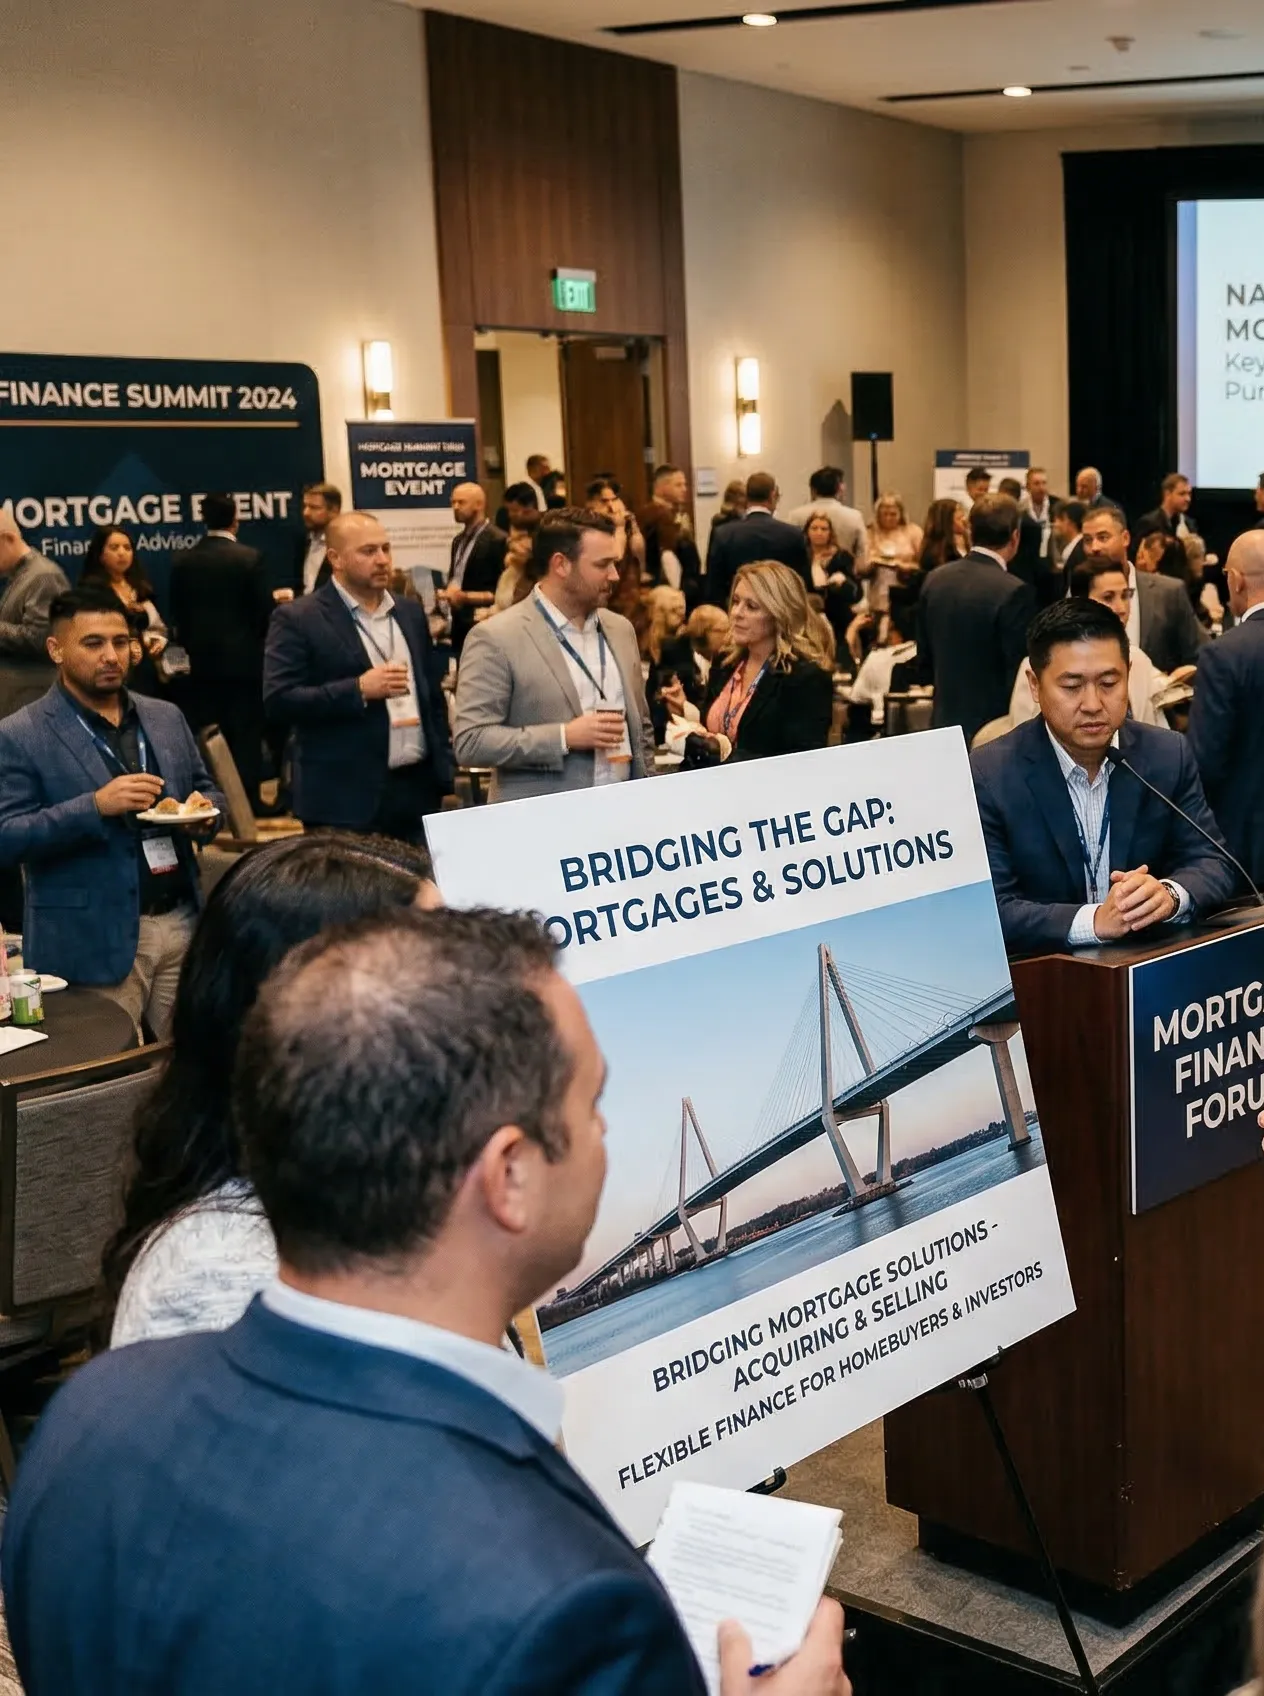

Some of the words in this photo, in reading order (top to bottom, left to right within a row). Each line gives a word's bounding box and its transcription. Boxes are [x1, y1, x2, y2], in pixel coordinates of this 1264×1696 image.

[126, 383, 233, 409] SUMMIT
[237, 386, 298, 410] 2024
[191, 491, 293, 522] EENT
[360, 461, 466, 478] MORTGAGE
[384, 480, 446, 496] EVENT
[543, 876, 743, 951] ORTGAGES
[752, 870, 776, 903] &
[781, 829, 954, 896] SOLUTIONS
[560, 826, 743, 893] BRIDGING
[748, 811, 816, 852] THE
[823, 797, 895, 837] GAP:
[652, 1324, 764, 1393] BRIDGING
[768, 1267, 883, 1339] MORTGAGE
[886, 1220, 989, 1283] SOLUTIONS
[733, 1317, 850, 1393] ACQUIRING
[854, 1308, 868, 1331] &
[871, 1270, 948, 1323] SELLING
[618, 1426, 712, 1490] FLEXIBLE
[715, 1384, 797, 1441] FINANCE
[799, 1365, 837, 1398] FOR
[838, 1307, 949, 1379] HOMEBUYERS
[952, 1302, 963, 1321] &
[964, 1260, 1043, 1314] INVESTORS
